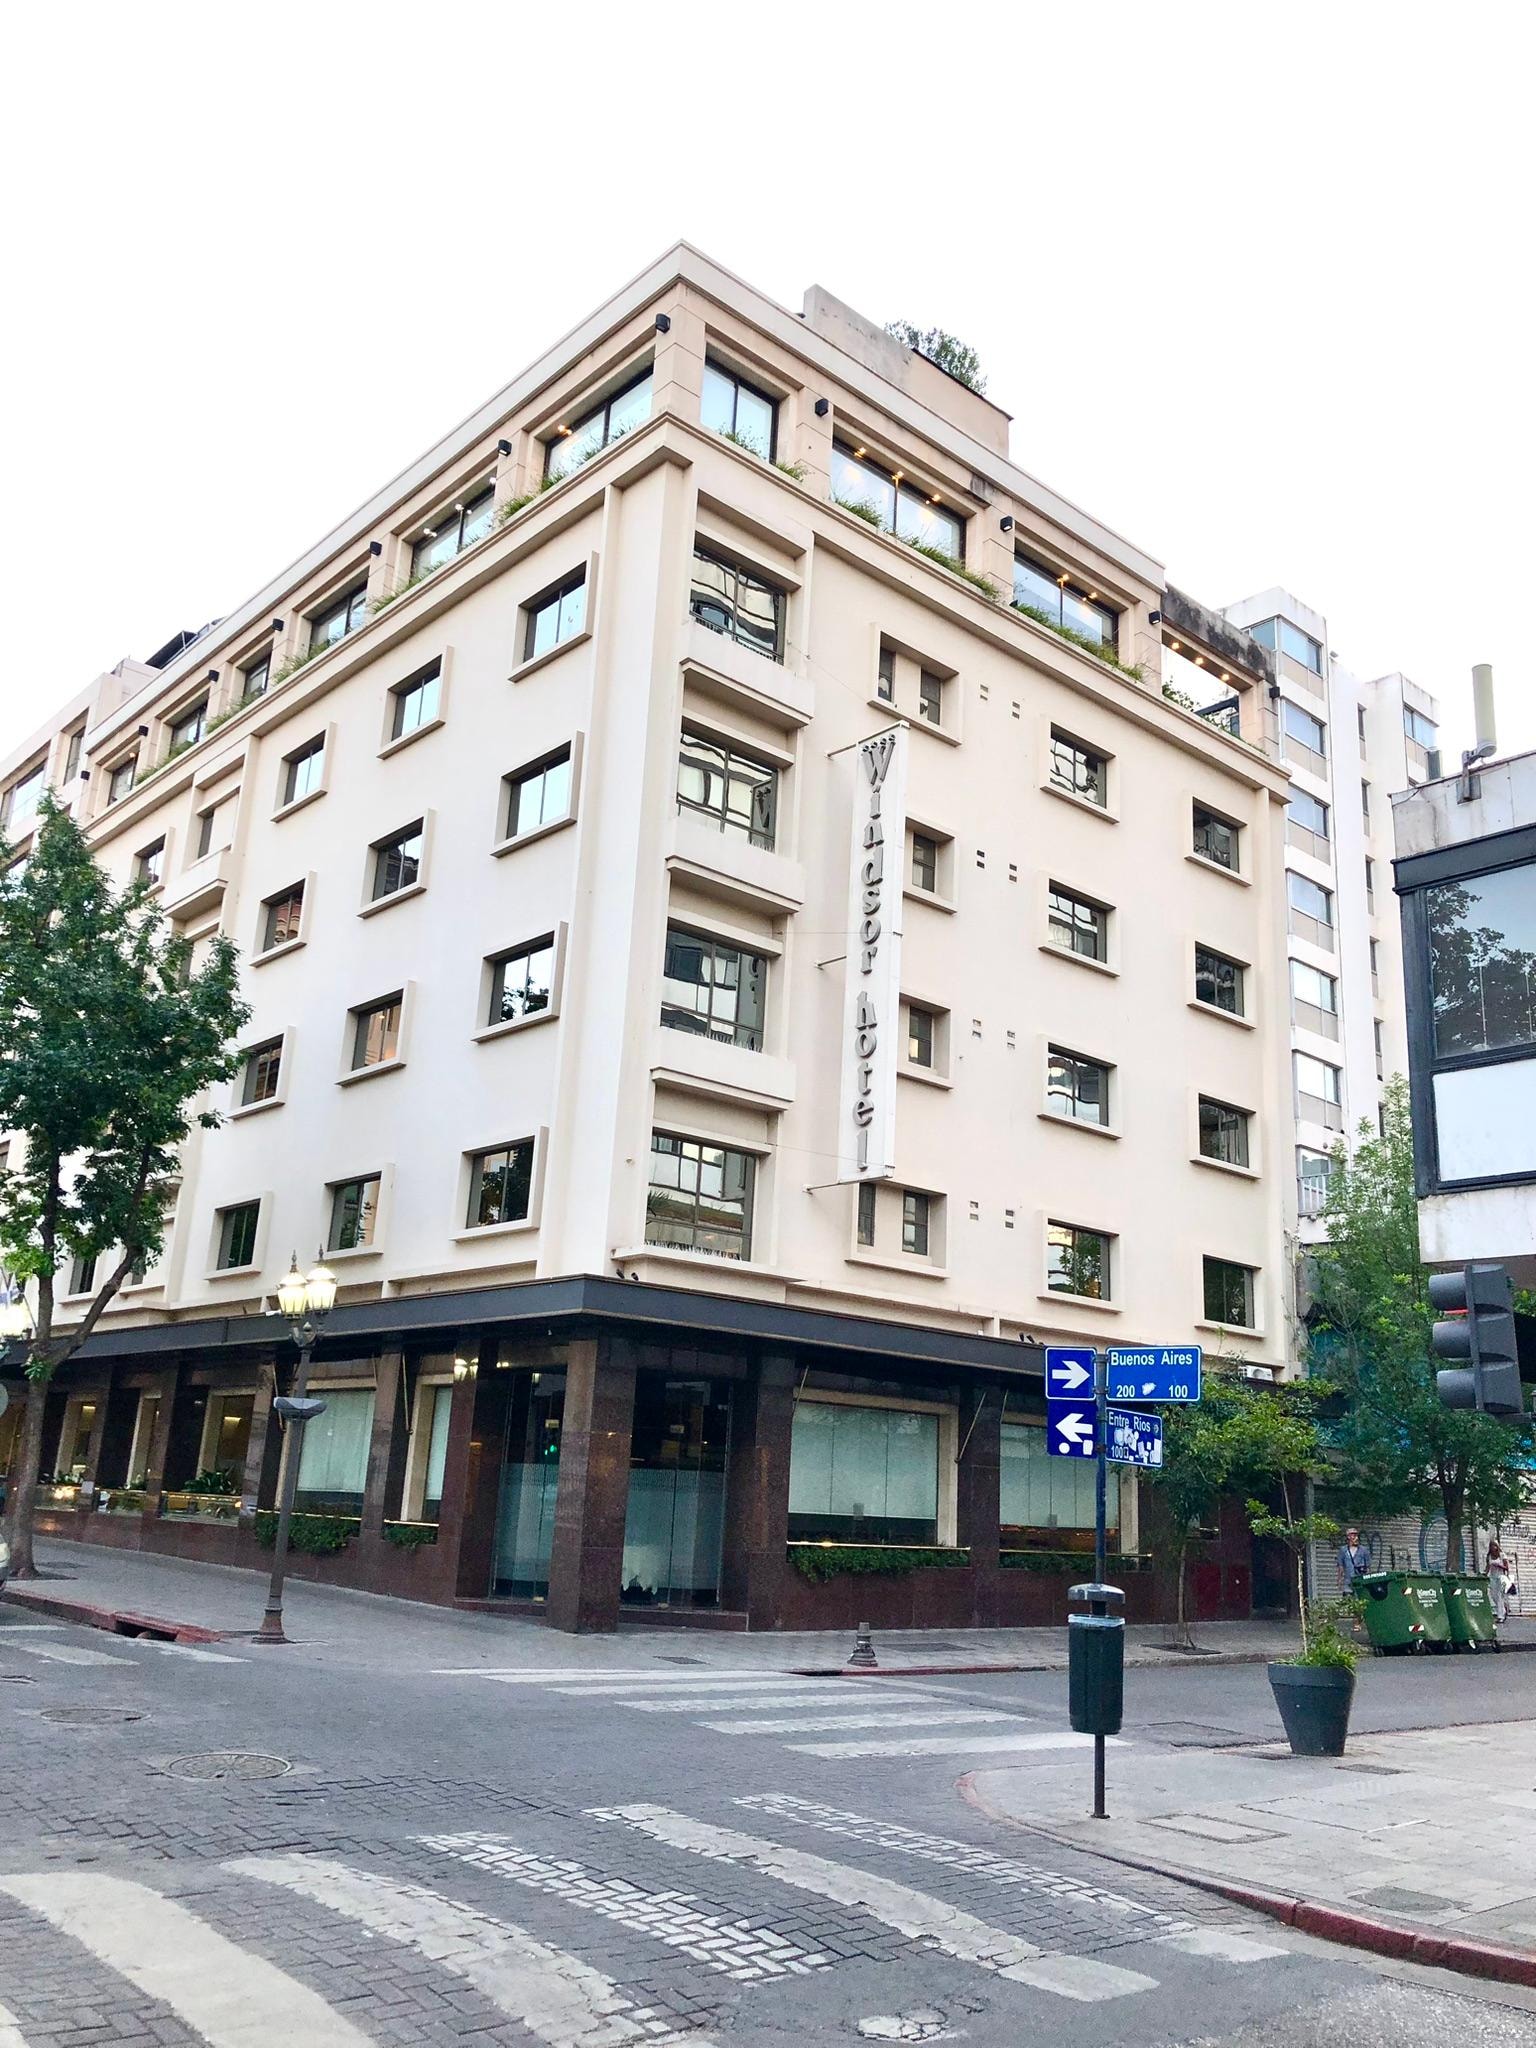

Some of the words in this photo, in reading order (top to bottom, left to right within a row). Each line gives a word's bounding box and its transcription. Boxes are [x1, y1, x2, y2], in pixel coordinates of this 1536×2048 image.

[860, 734, 896, 975] Windsor
[852, 990, 878, 1172] hotel
[1110, 1351, 1155, 1366] Buenos
[1161, 1350, 1193, 1366] Aires
[1116, 1385, 1135, 1398] 200
[1169, 1385, 1188, 1398] 100
[1108, 1411, 1130, 1428] Entre
